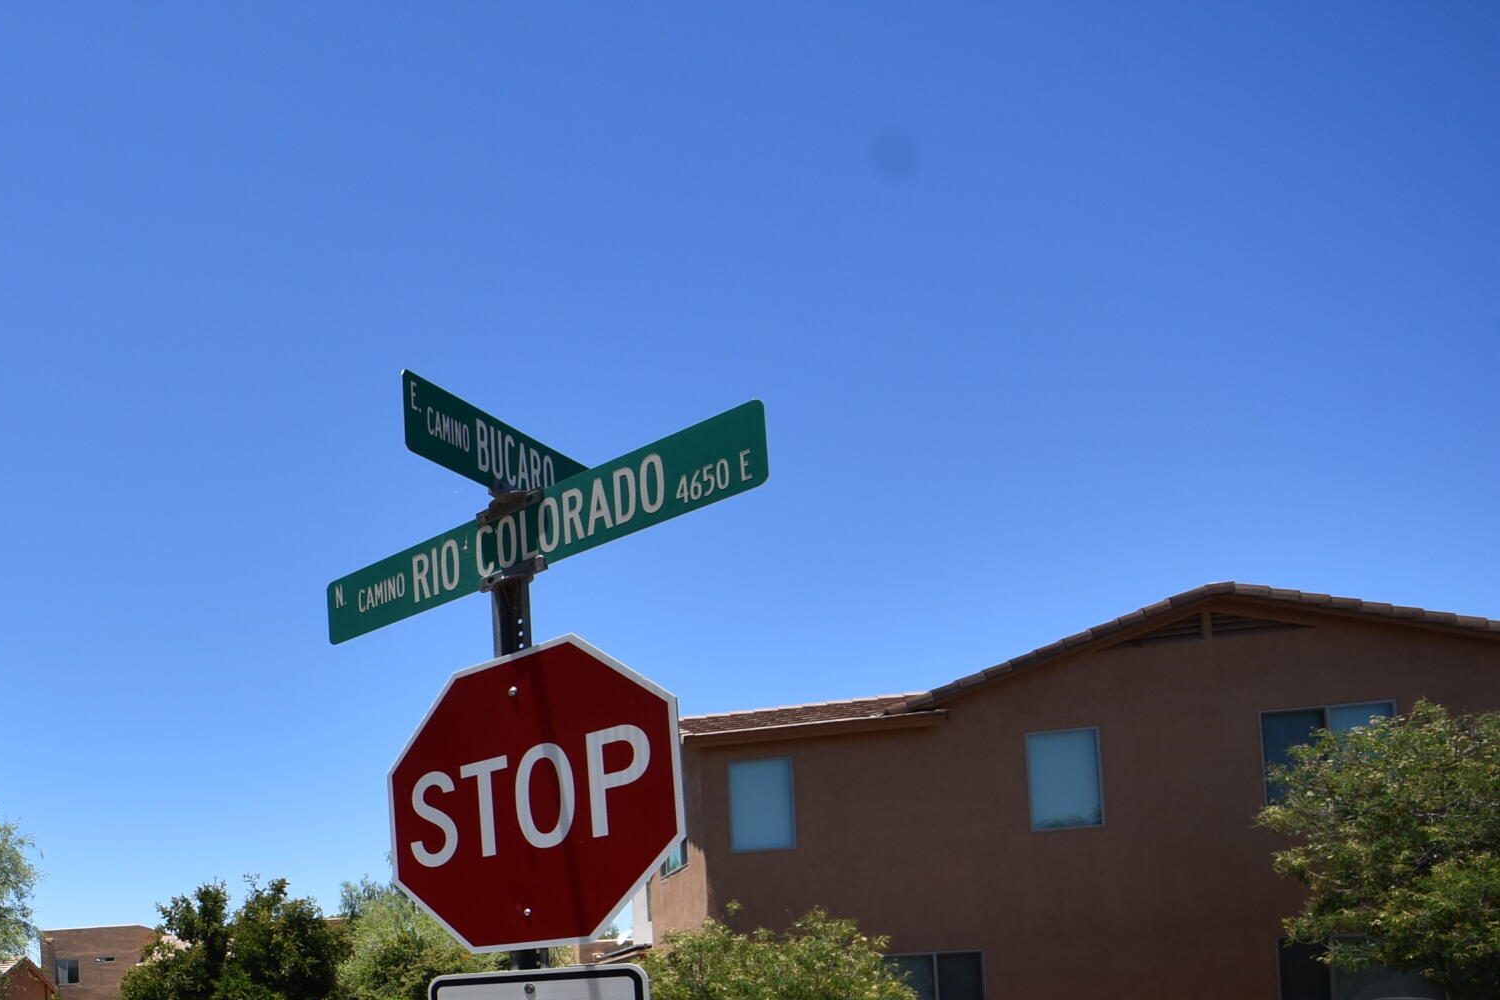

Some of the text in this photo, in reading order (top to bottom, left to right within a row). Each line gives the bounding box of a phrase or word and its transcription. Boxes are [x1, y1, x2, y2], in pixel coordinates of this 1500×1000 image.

[410, 380, 555, 491] E. CAMINO BUCARO
[334, 449, 753, 613] N. CAMINO RIO COLORADO 4650 E
[410, 723, 651, 868] STOP
